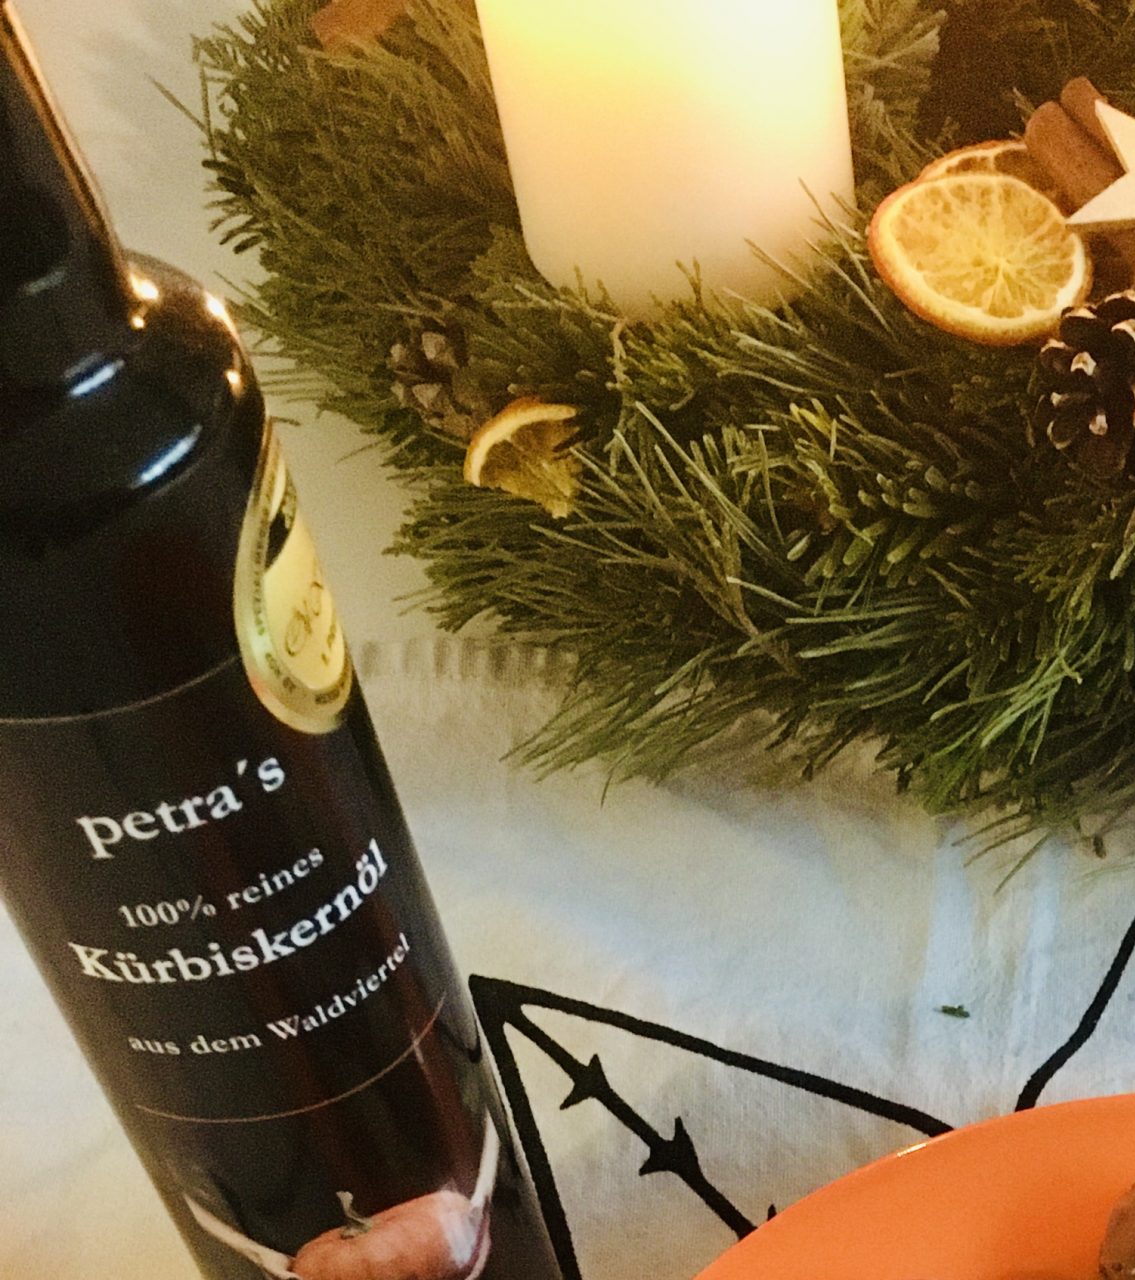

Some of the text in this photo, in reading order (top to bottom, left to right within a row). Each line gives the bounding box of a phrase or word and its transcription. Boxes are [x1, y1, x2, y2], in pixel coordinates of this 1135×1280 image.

[69, 838, 389, 984] Kürbiskernöl
[120, 847, 324, 928] 100% reines
[128, 933, 411, 1056] aus dem Waldviertel
